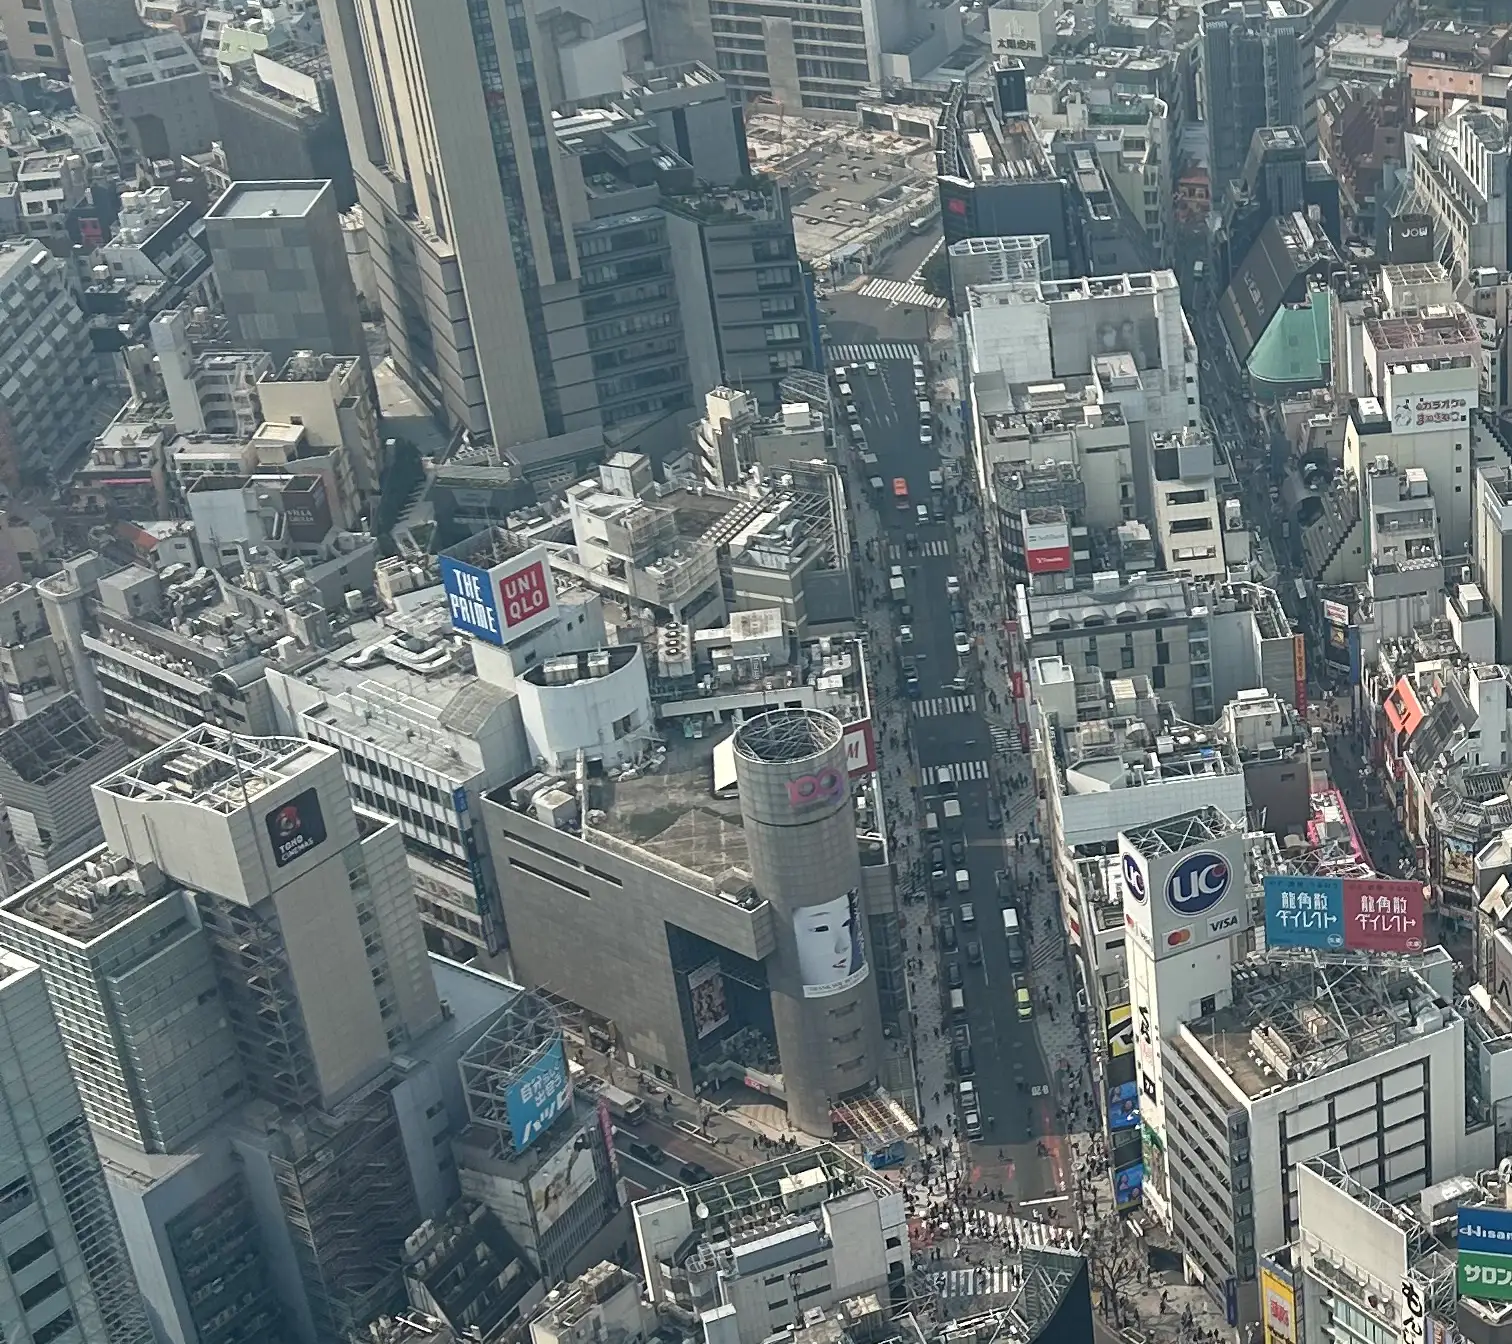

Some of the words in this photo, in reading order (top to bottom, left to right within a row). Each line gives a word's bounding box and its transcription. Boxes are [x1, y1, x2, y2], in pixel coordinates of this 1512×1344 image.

[452, 568, 483, 603] THE
[504, 570, 539, 599] UNI
[449, 592, 498, 633] PRIME
[509, 588, 544, 620] QLO
[785, 767, 843, 806] 109
[1171, 863, 1226, 903] UC
[1281, 891, 1328, 911] 龍角散
[1360, 894, 1408, 915] 龍角散
[1210, 915, 1238, 933] VISA
